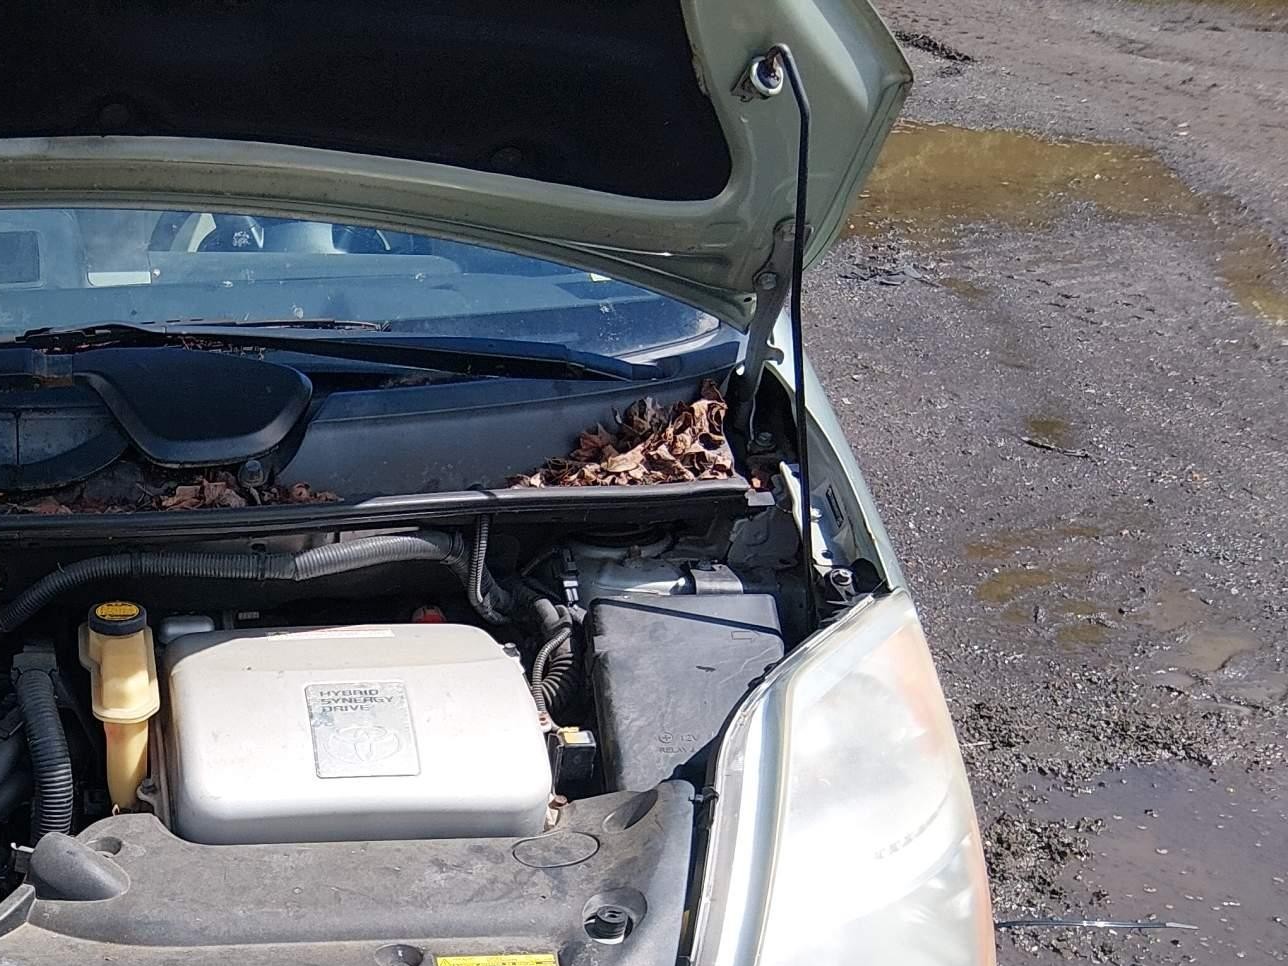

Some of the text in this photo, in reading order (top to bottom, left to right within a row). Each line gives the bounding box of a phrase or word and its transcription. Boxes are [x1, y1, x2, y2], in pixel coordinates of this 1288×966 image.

[319, 688, 379, 697] HYBRID
[320, 696, 394, 705] SYNERGY
[322, 705, 369, 713] DRIVE
